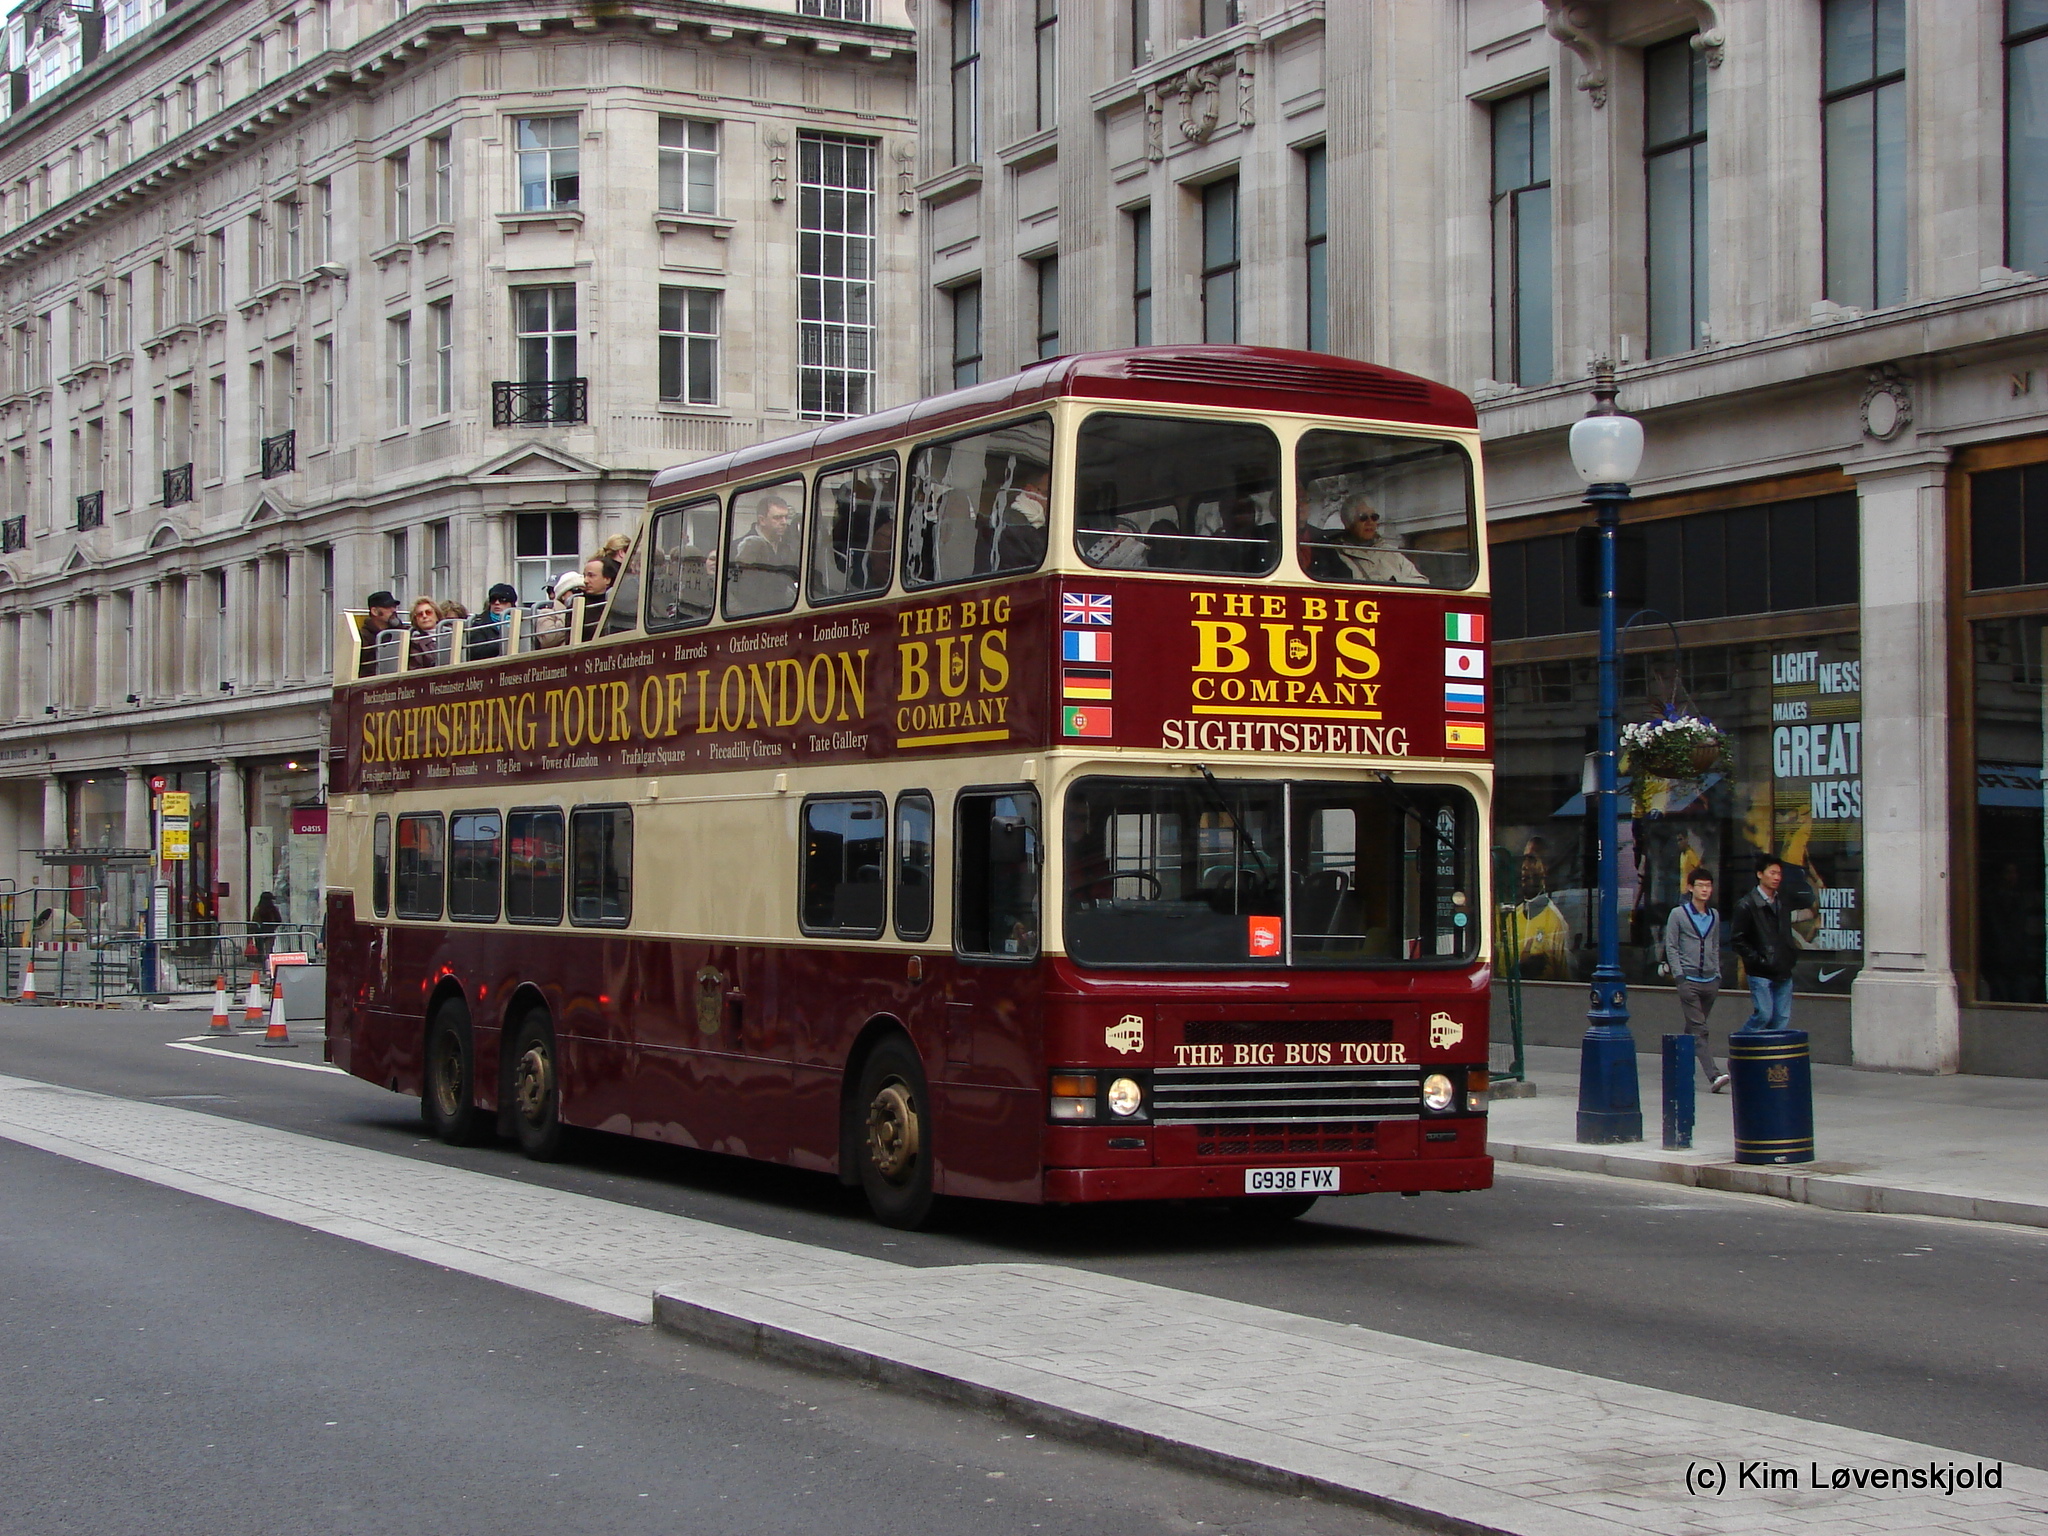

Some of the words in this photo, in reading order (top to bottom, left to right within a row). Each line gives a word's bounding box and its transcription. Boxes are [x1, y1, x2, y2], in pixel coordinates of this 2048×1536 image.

[898, 605, 952, 637] THE
[961, 595, 1011, 628] BIG
[1190, 592, 1287, 619] THE
[1302, 597, 1381, 624] BIG
[363, 689, 397, 705] Buckingham
[397, 686, 416, 700] Palace
[429, 681, 464, 695] Westminster
[465, 676, 484, 692] Abbey
[499, 672, 523, 687] Houses
[523, 668, 531, 682] of
[531, 665, 568, 681] Parliament
[585, 659, 594, 674] St
[594, 655, 616, 673] Paul's
[617, 649, 654, 669] Cathedral
[674, 642, 708, 661] Harrods
[729, 633, 759, 654] Oxford
[760, 632, 789, 650] Street
[813, 621, 849, 642] London
[851, 618, 870, 641] Eye
[897, 628, 1010, 701] BUS
[1191, 620, 1381, 680] BUS
[362, 692, 537, 763] SIGHTSEEING
[545, 681, 631, 748] TOUR
[640, 672, 687, 739] OF
[695, 649, 870, 735] LONDON
[1191, 677, 1381, 706] COMPANY
[897, 696, 1009, 732] COMPANY
[1773, 702, 1807, 722] MAKES
[1162, 719, 1410, 756] SIGHTSEEING
[1772, 722, 1861, 778] GREAT
[362, 769, 392, 783] Kensington
[392, 767, 410, 780] Palace
[427, 764, 450, 778] Madame
[452, 761, 478, 776] Tussauds
[496, 759, 508, 776] Big
[508, 758, 522, 773] Ben
[541, 755, 563, 770] Tower
[563, 753, 571, 769] of
[572, 752, 599, 768] London
[621, 748, 655, 767] Trafalgar
[656, 747, 685, 765] Square
[709, 741, 752, 761] Piccadilly
[753, 739, 782, 757] Circus
[809, 734, 831, 752] Tate
[832, 730, 868, 751] Gallery
[154, 780, 165, 788] RF
[1811, 780, 1862, 820] NESS
[1818, 888, 1855, 909] WRITE
[1819, 908, 1841, 929] THE
[1818, 929, 1861, 950] FUTURE
[1174, 1044, 1224, 1067] THE
[1233, 1043, 1275, 1065] BIG
[1284, 1043, 1332, 1065] BUS
[1340, 1042, 1407, 1065] TOUR
[1253, 1171, 1296, 1189] G938
[1301, 1170, 1333, 1188] FVX
